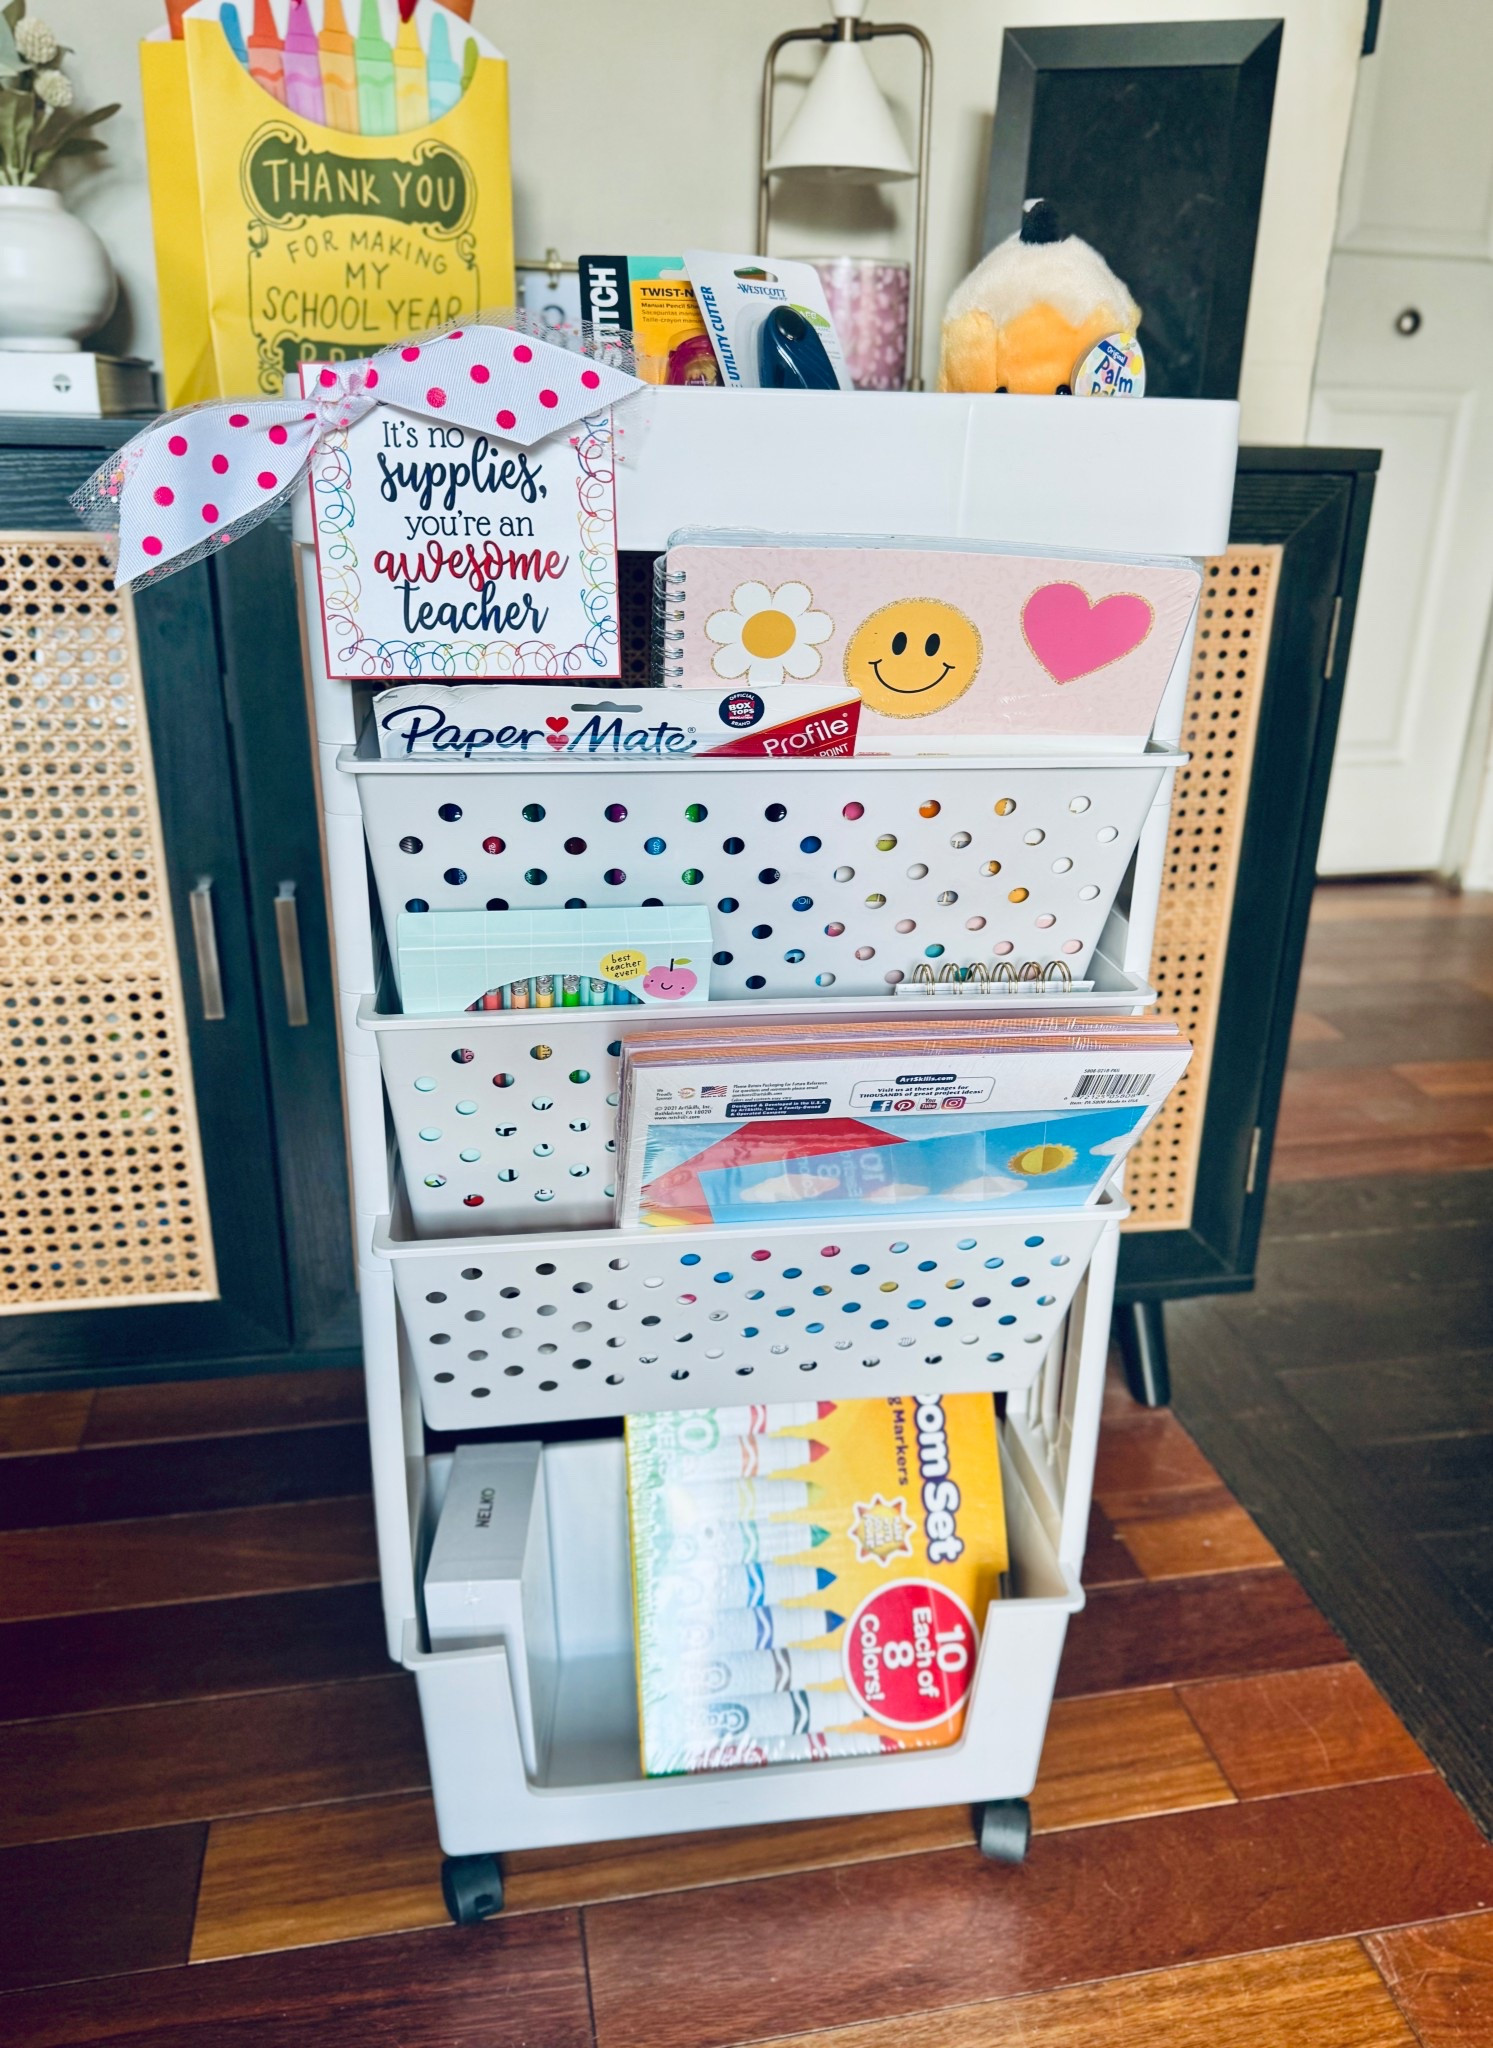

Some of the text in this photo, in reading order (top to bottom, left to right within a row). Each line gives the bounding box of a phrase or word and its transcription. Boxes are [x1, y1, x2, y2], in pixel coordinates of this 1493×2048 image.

[262, 158, 455, 212] THANK YOU
[286, 230, 448, 275] FOR MAKING
[346, 262, 390, 290] MY
[737, 283, 786, 298] WESTCOTT
[262, 286, 463, 332] SCHOOL YEAR
[700, 286, 725, 332] CUTTER
[716, 334, 740, 381] UTILITY
[1094, 355, 1133, 393] Palm
[1106, 345, 1127, 363] Original
[382, 421, 465, 449] It's no
[377, 436, 548, 511] supplies,
[405, 510, 535, 540] you're an
[374, 540, 570, 592] awesome
[394, 579, 549, 633] teacher
[728, 702, 751, 710] BOX
[382, 705, 546, 758] Paper
[762, 719, 849, 757] Profile
[605, 960, 642, 972] teacher
[611, 954, 631, 963] best
[900, 1075, 954, 1083] ArtSkills.com
[893, 1409, 909, 1486] Markers
[475, 1487, 496, 1528] NELKO
[859, 1614, 886, 1701] Colors!
[883, 1641, 915, 1669] 8
[912, 1606, 940, 1698] Each of
[935, 1624, 968, 1673] 10
